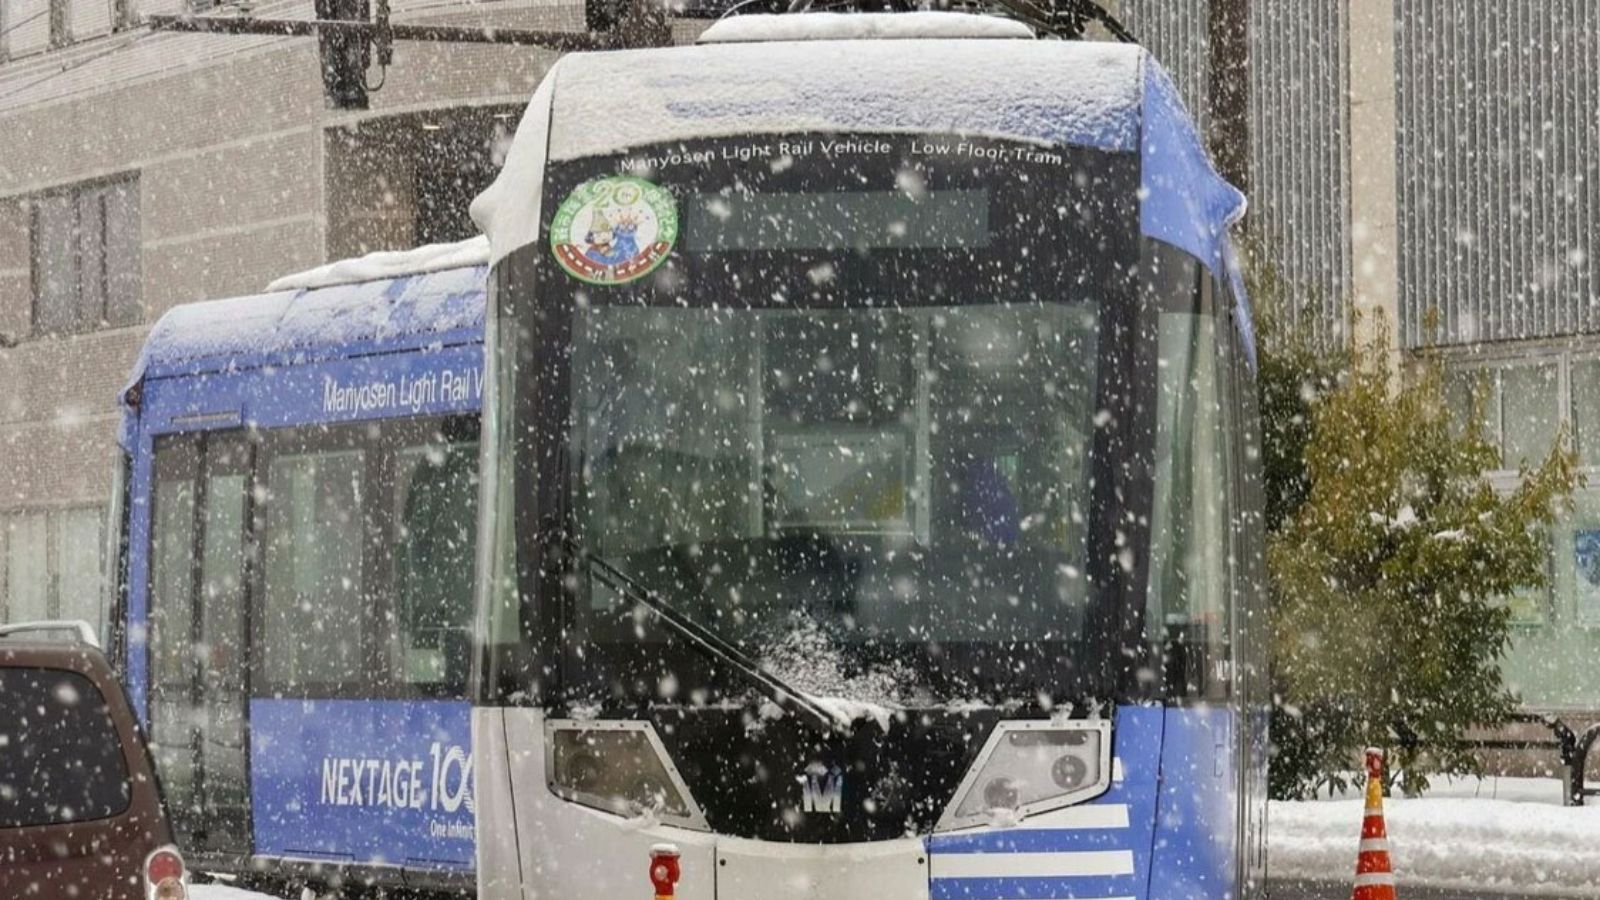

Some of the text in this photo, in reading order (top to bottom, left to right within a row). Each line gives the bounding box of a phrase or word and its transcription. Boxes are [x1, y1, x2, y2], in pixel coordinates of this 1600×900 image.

[621, 140, 1062, 172] Manyosen Light Rail Vehicle Low Floor Tram
[323, 376, 396, 418] Manyosen
[400, 373, 436, 413] Light
[441, 368, 471, 402] Rail
[321, 758, 424, 809] NEXTAGE
